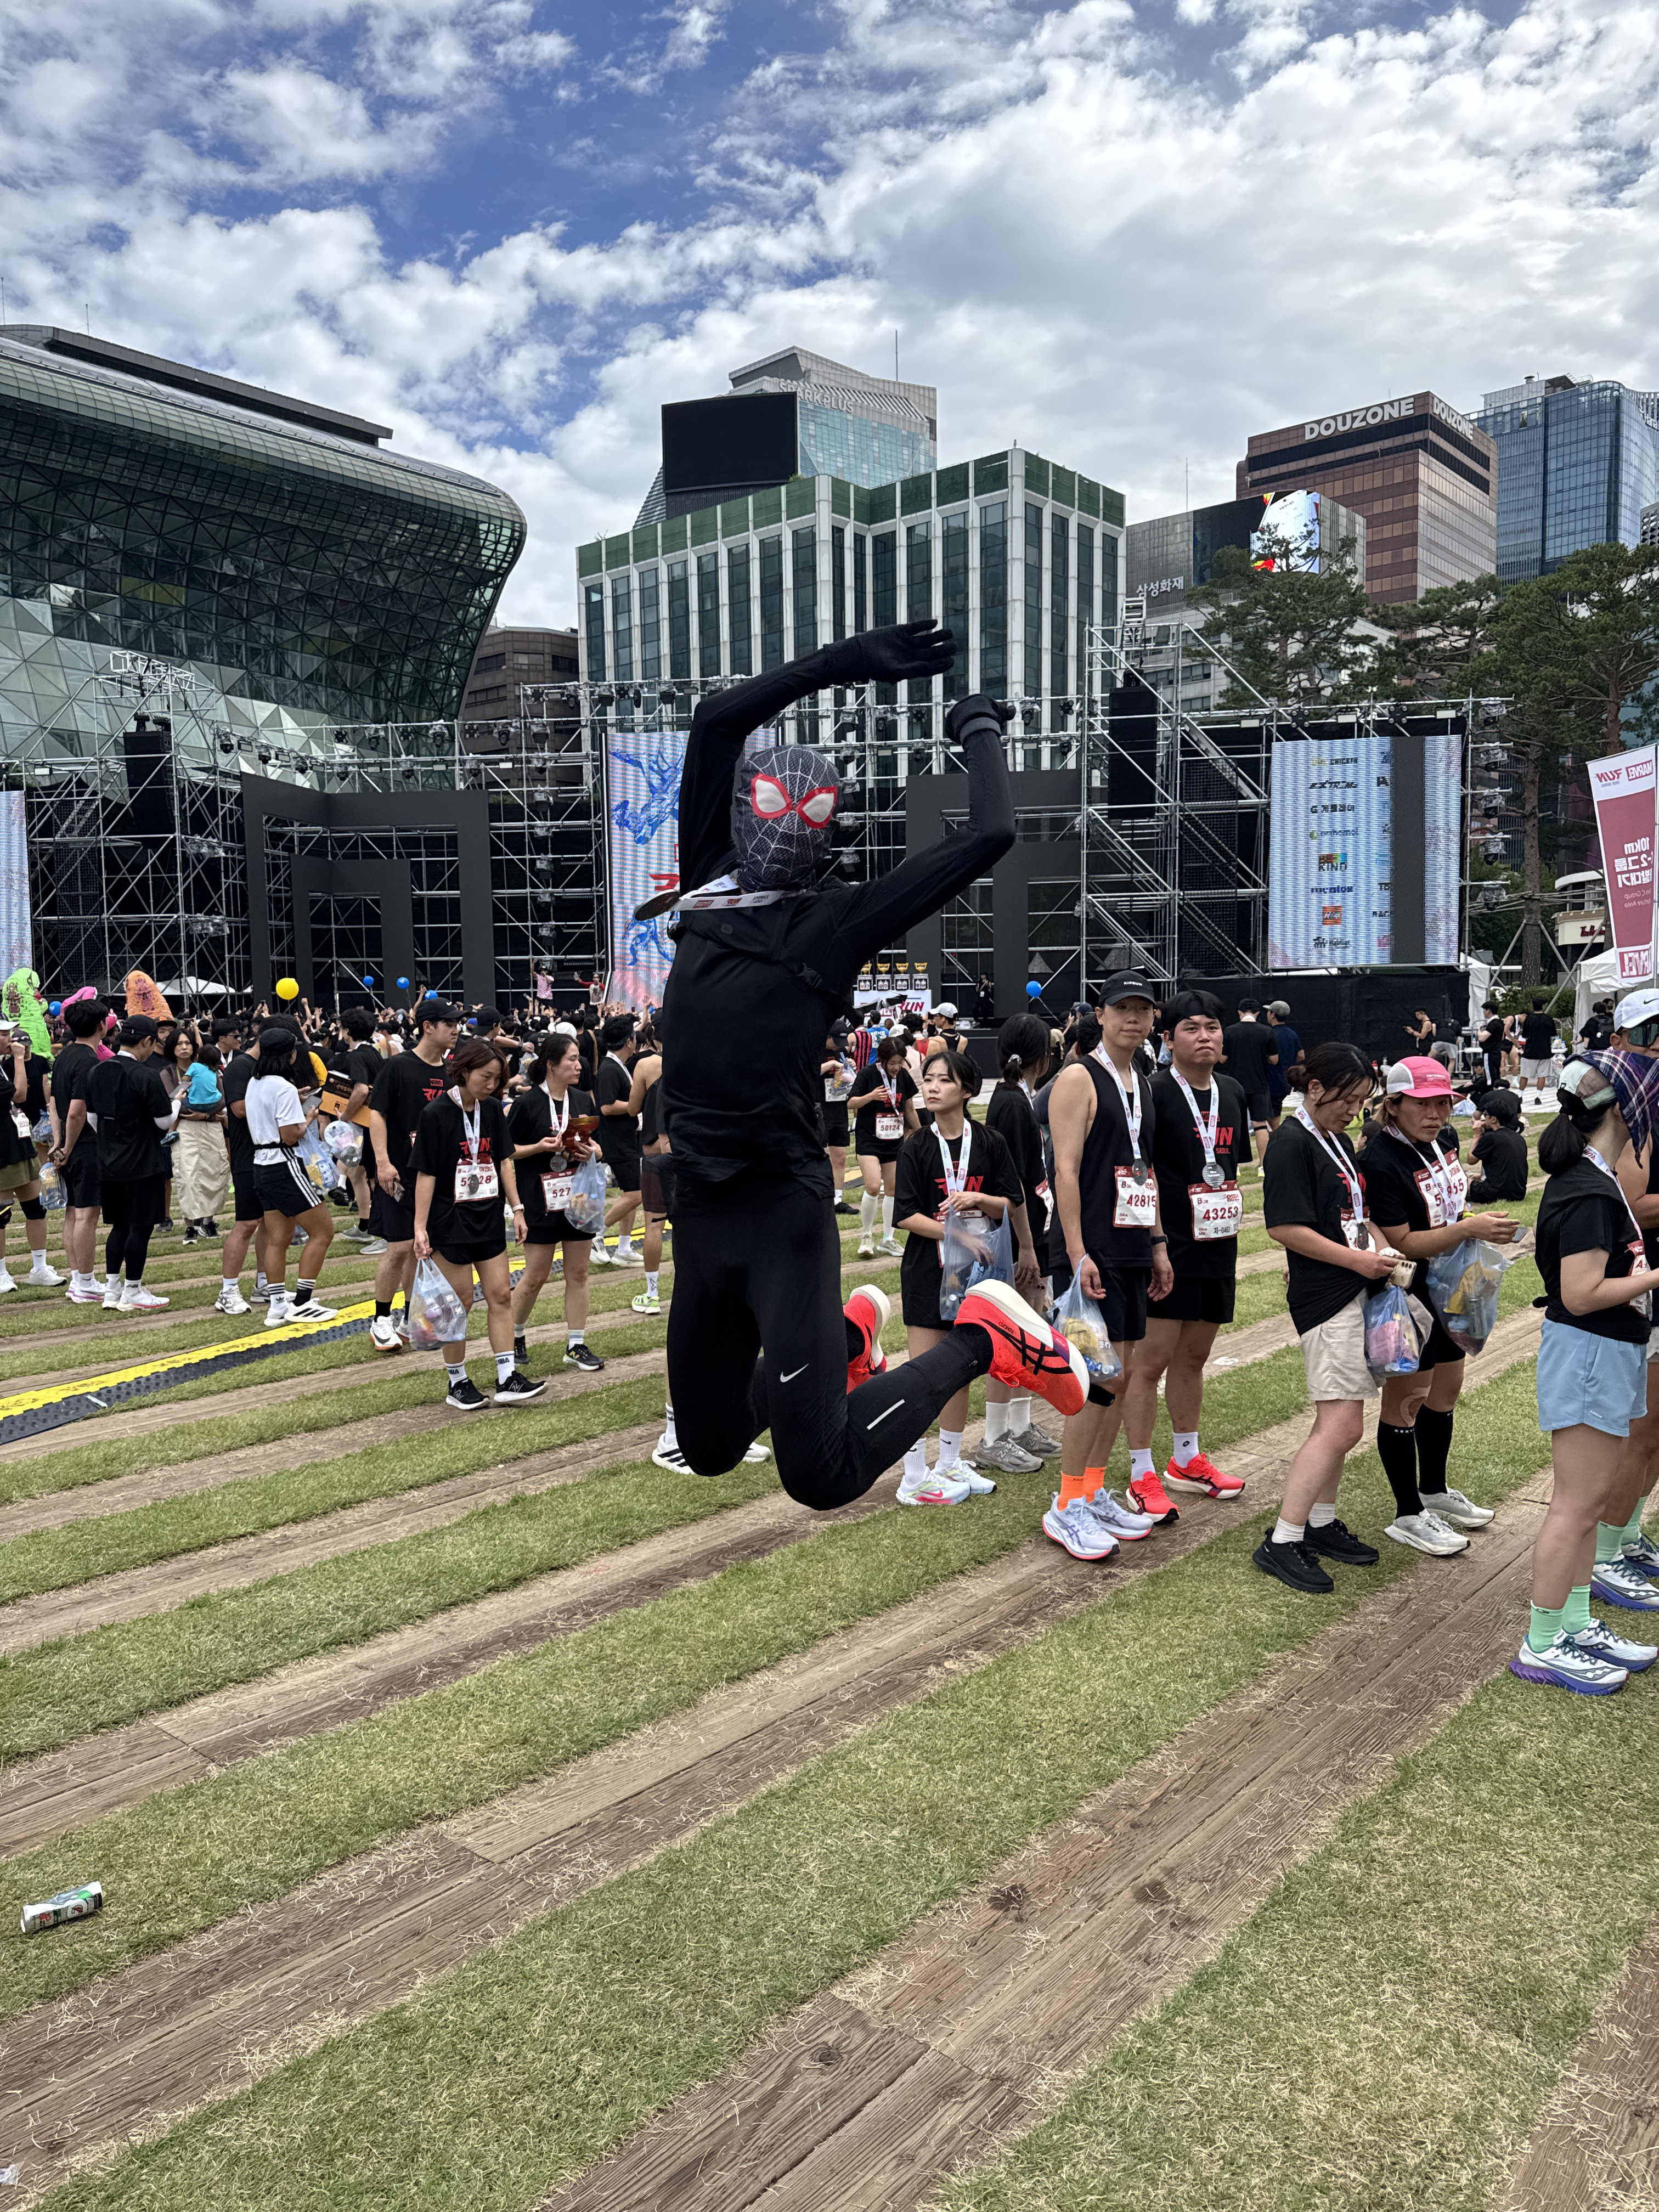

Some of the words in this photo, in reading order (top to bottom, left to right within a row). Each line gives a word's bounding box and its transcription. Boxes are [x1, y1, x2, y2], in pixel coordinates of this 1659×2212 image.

[1305, 397, 1414, 441] DOUZONE
[1433, 396, 1474, 441] DOUZONE
[1136, 575, 1184, 598] 삼성화재
[459, 1137, 491, 1155] RN
[461, 1175, 492, 1187] 528
[934, 1176, 984, 1195] RN
[1425, 1183, 1432, 1192] B
[552, 1187, 571, 1198] 527
[1126, 1194, 1156, 1207] 42815
[1202, 1206, 1239, 1221] 43253
[1635, 1260, 1643, 1269] A
[998, 1322, 1014, 1334] TOKYO
